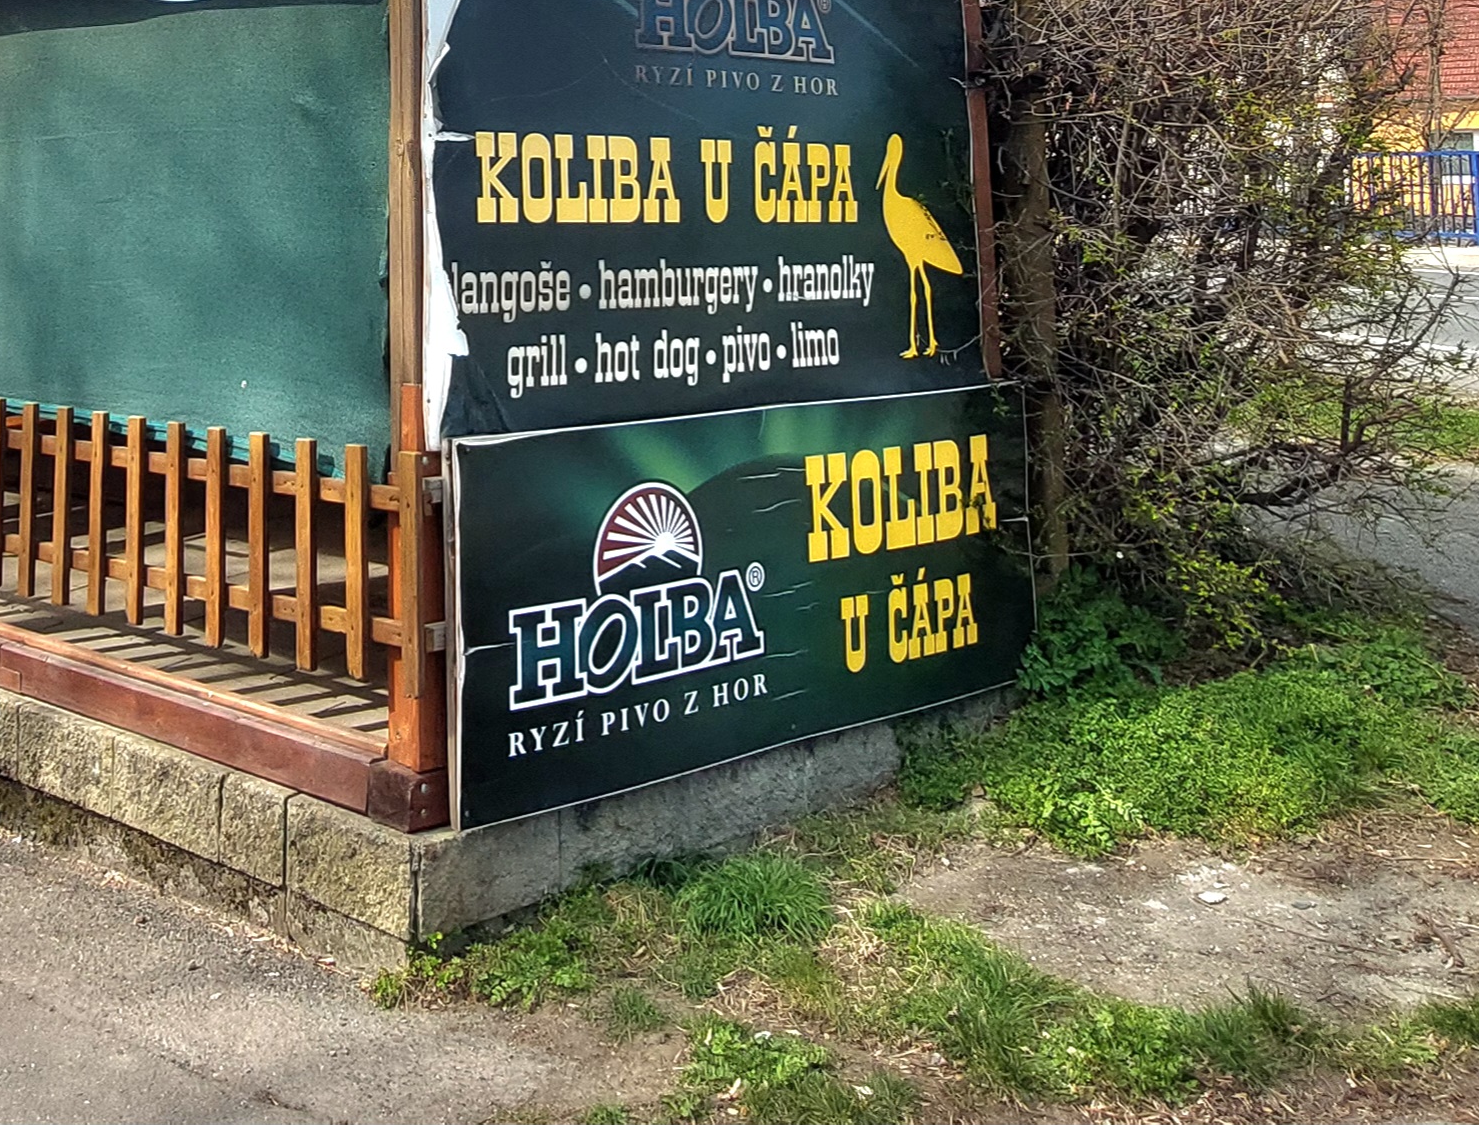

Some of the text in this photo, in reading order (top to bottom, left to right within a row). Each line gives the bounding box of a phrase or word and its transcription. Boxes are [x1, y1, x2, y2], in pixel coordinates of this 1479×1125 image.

[635, 62, 839, 96] RYZÍ PIVO Z HOR
[475, 125, 858, 224] KOLIBA U ČÁPA
[451, 255, 874, 323] langoše hamburgery hranolky
[507, 321, 840, 398] grill hot dog pivo limo
[805, 434, 997, 563] KOLIBA
[840, 567, 978, 673] U ČÁPA
[508, 673, 768, 757] RYZÍ PIVO Z HOR
